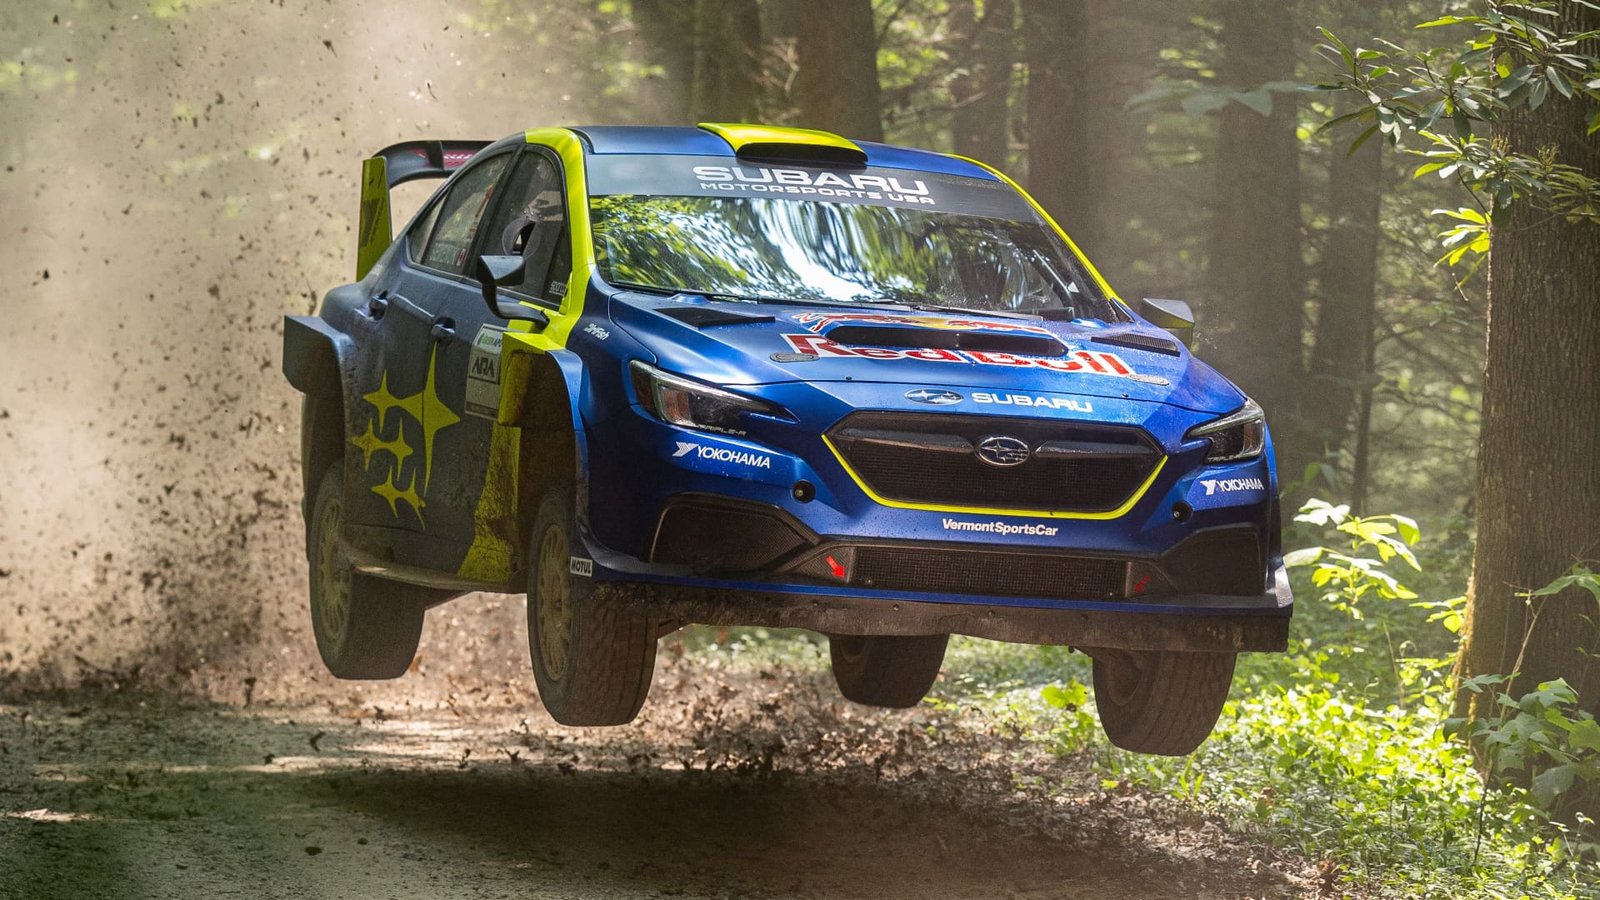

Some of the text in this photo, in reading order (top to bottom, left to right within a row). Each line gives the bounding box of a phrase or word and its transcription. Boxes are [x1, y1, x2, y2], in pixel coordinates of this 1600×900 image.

[693, 167, 929, 195] SUBARU
[701, 183, 935, 205] MOTORSPORTS USA
[780, 334, 1136, 377] Red Bull
[472, 357, 495, 378] ARA
[971, 392, 1093, 412] SUBARU
[697, 446, 770, 469] YOKOHAMA
[1216, 478, 1265, 492] YOKOHAMA
[942, 518, 1058, 535] VermontSportsCar
[571, 560, 591, 574] MOTUL
